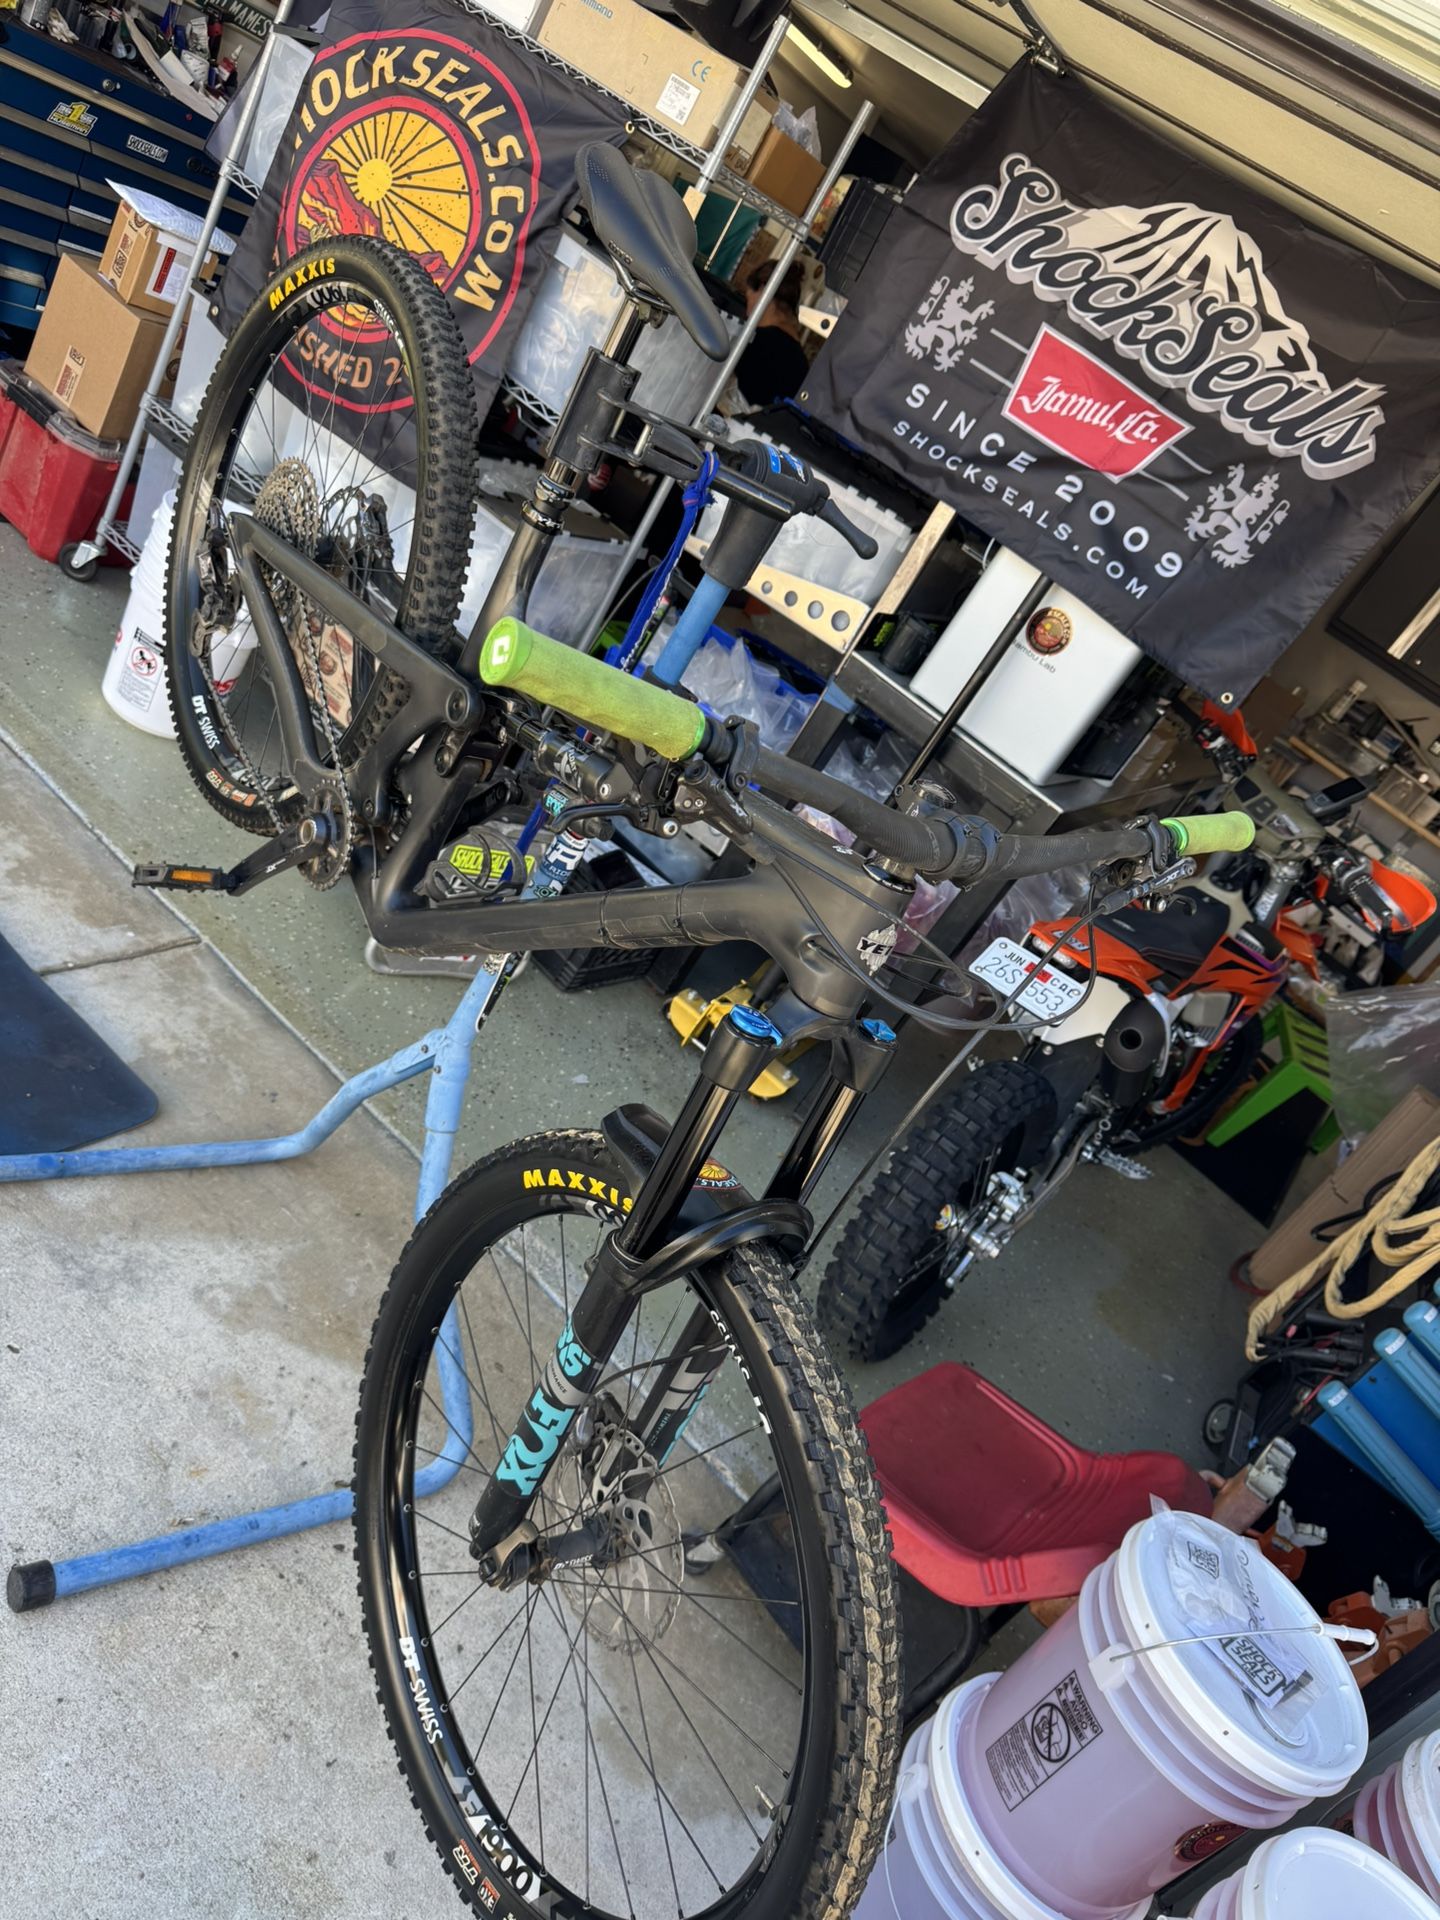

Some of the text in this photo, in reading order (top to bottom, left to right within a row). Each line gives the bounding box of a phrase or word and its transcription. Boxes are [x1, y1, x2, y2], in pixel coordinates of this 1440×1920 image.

[269, 257, 335, 311] MAXXIS
[950, 153, 1387, 480] ShockSeals
[1017, 376, 1116, 433] Jamul,
[905, 383, 1183, 578] SINCE 2009
[893, 420, 1149, 600] SHOCKSEALS.COM
[1039, 658, 1056, 674] Lab
[192, 695, 208, 715] DT
[199, 717, 220, 751] SWISS
[1004, 952, 1026, 967] JUN
[523, 1169, 633, 1213] MAXXIS
[496, 1388, 576, 1496] FOX
[1231, 1645, 1270, 1687] SEALS
[1236, 1637, 1281, 1682] SHOCK
[399, 1637, 443, 1744] DT SWISS
[1070, 1700, 1088, 1730] AVISO
[1073, 1684, 1099, 1734] WARNING
[477, 1818, 533, 1896] 1900
